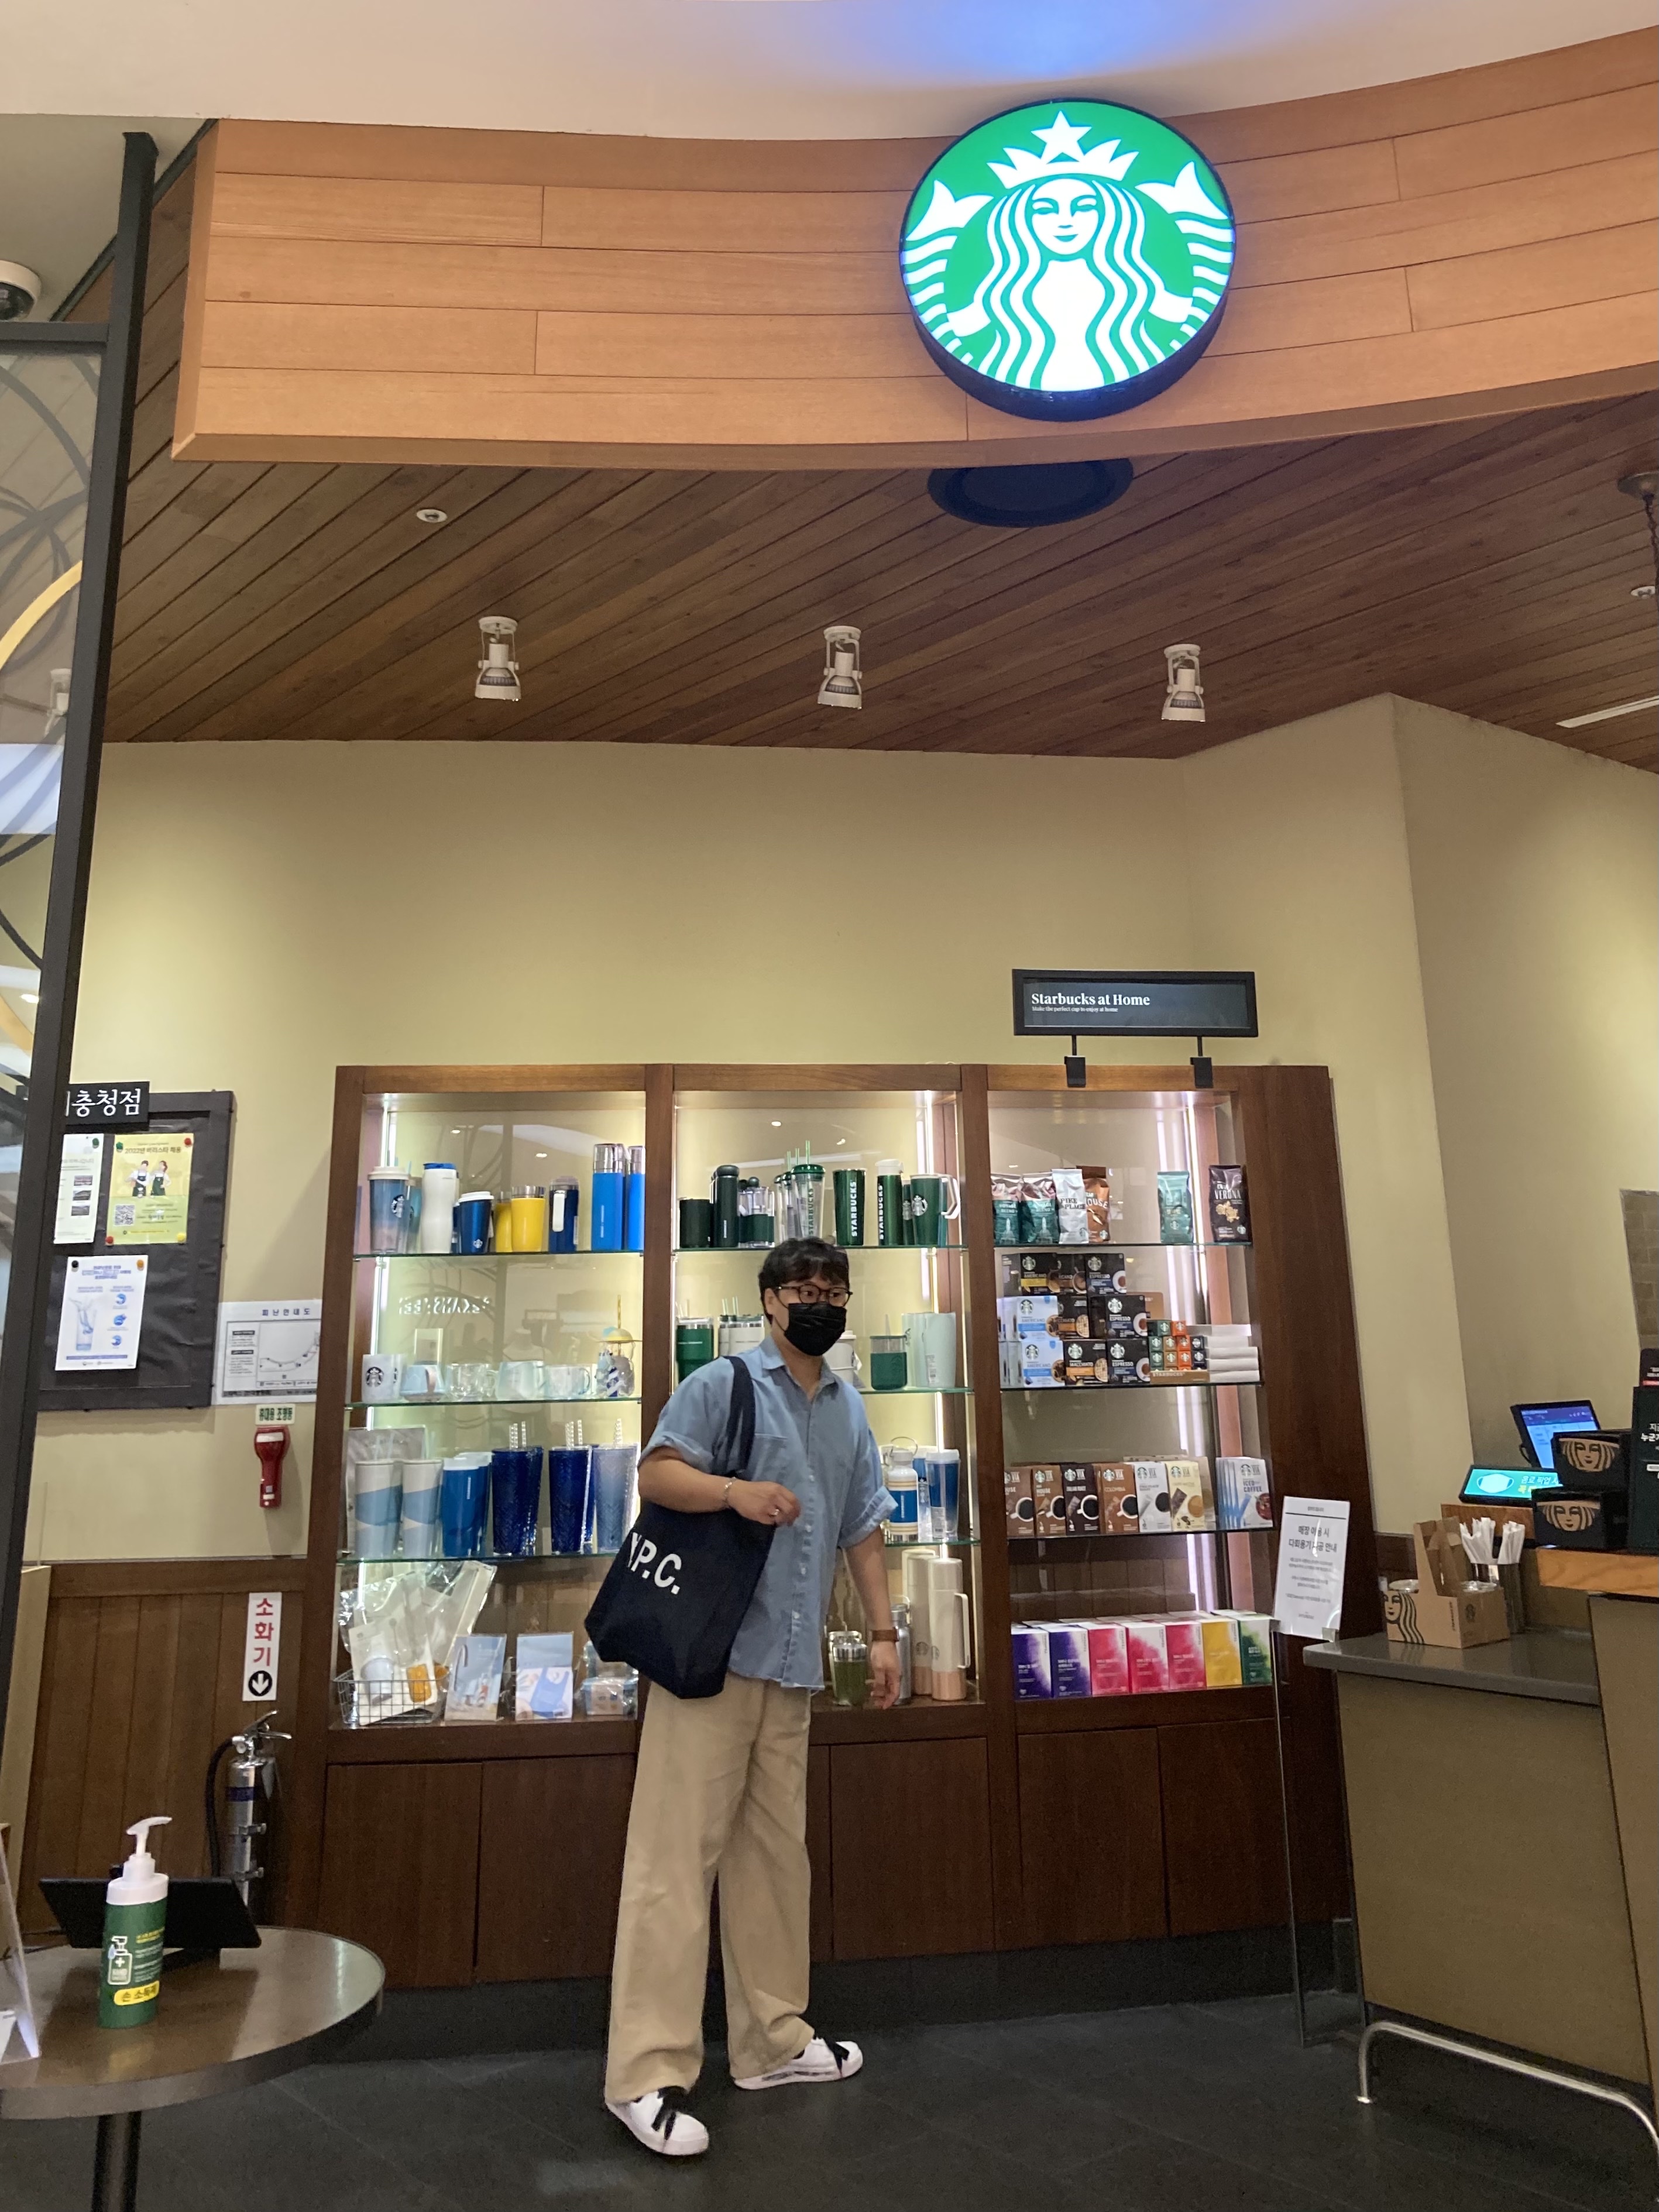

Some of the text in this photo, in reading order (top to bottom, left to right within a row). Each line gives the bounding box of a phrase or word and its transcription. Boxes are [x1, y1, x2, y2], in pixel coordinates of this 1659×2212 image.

[1031, 992, 1150, 1005] Starbucks at Home
[65, 1088, 141, 1117] 충청점
[1214, 1189, 1242, 1200] VERONA
[850, 1180, 858, 1237] STARBUCKS
[1521, 1475, 1536, 1485] 음료
[1537, 1476, 1551, 1485] 픽업
[1297, 1525, 1310, 1536] 매장
[1323, 1527, 1330, 1538] 시
[1288, 1538, 1311, 1550] 다회용기
[1325, 1542, 1338, 1553] 안내
[253, 1597, 274, 1667] 소화기
[122, 1991, 131, 2003] 손
